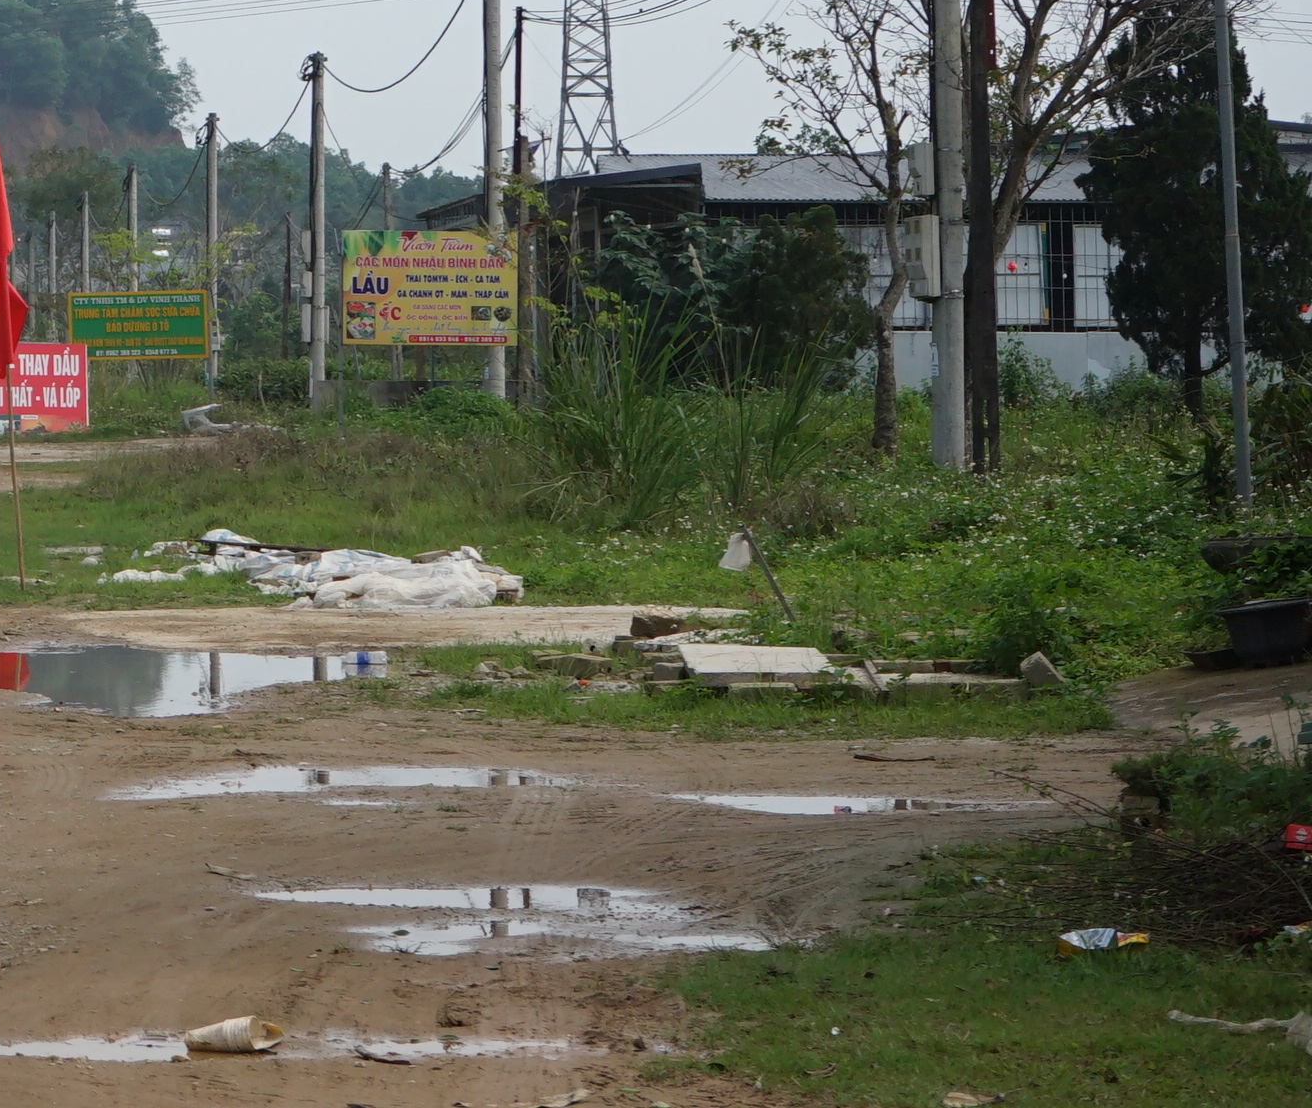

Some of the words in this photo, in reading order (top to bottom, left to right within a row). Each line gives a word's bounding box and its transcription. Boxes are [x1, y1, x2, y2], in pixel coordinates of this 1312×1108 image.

[73, 297, 89, 305] CTY
[90, 296, 114, 304] TNHH
[129, 296, 136, 304] &
[18, 354, 50, 376] THAY
[53, 347, 80, 376] DẦU
[43, 382, 57, 407] VÁ
[60, 379, 81, 408] LỐP
